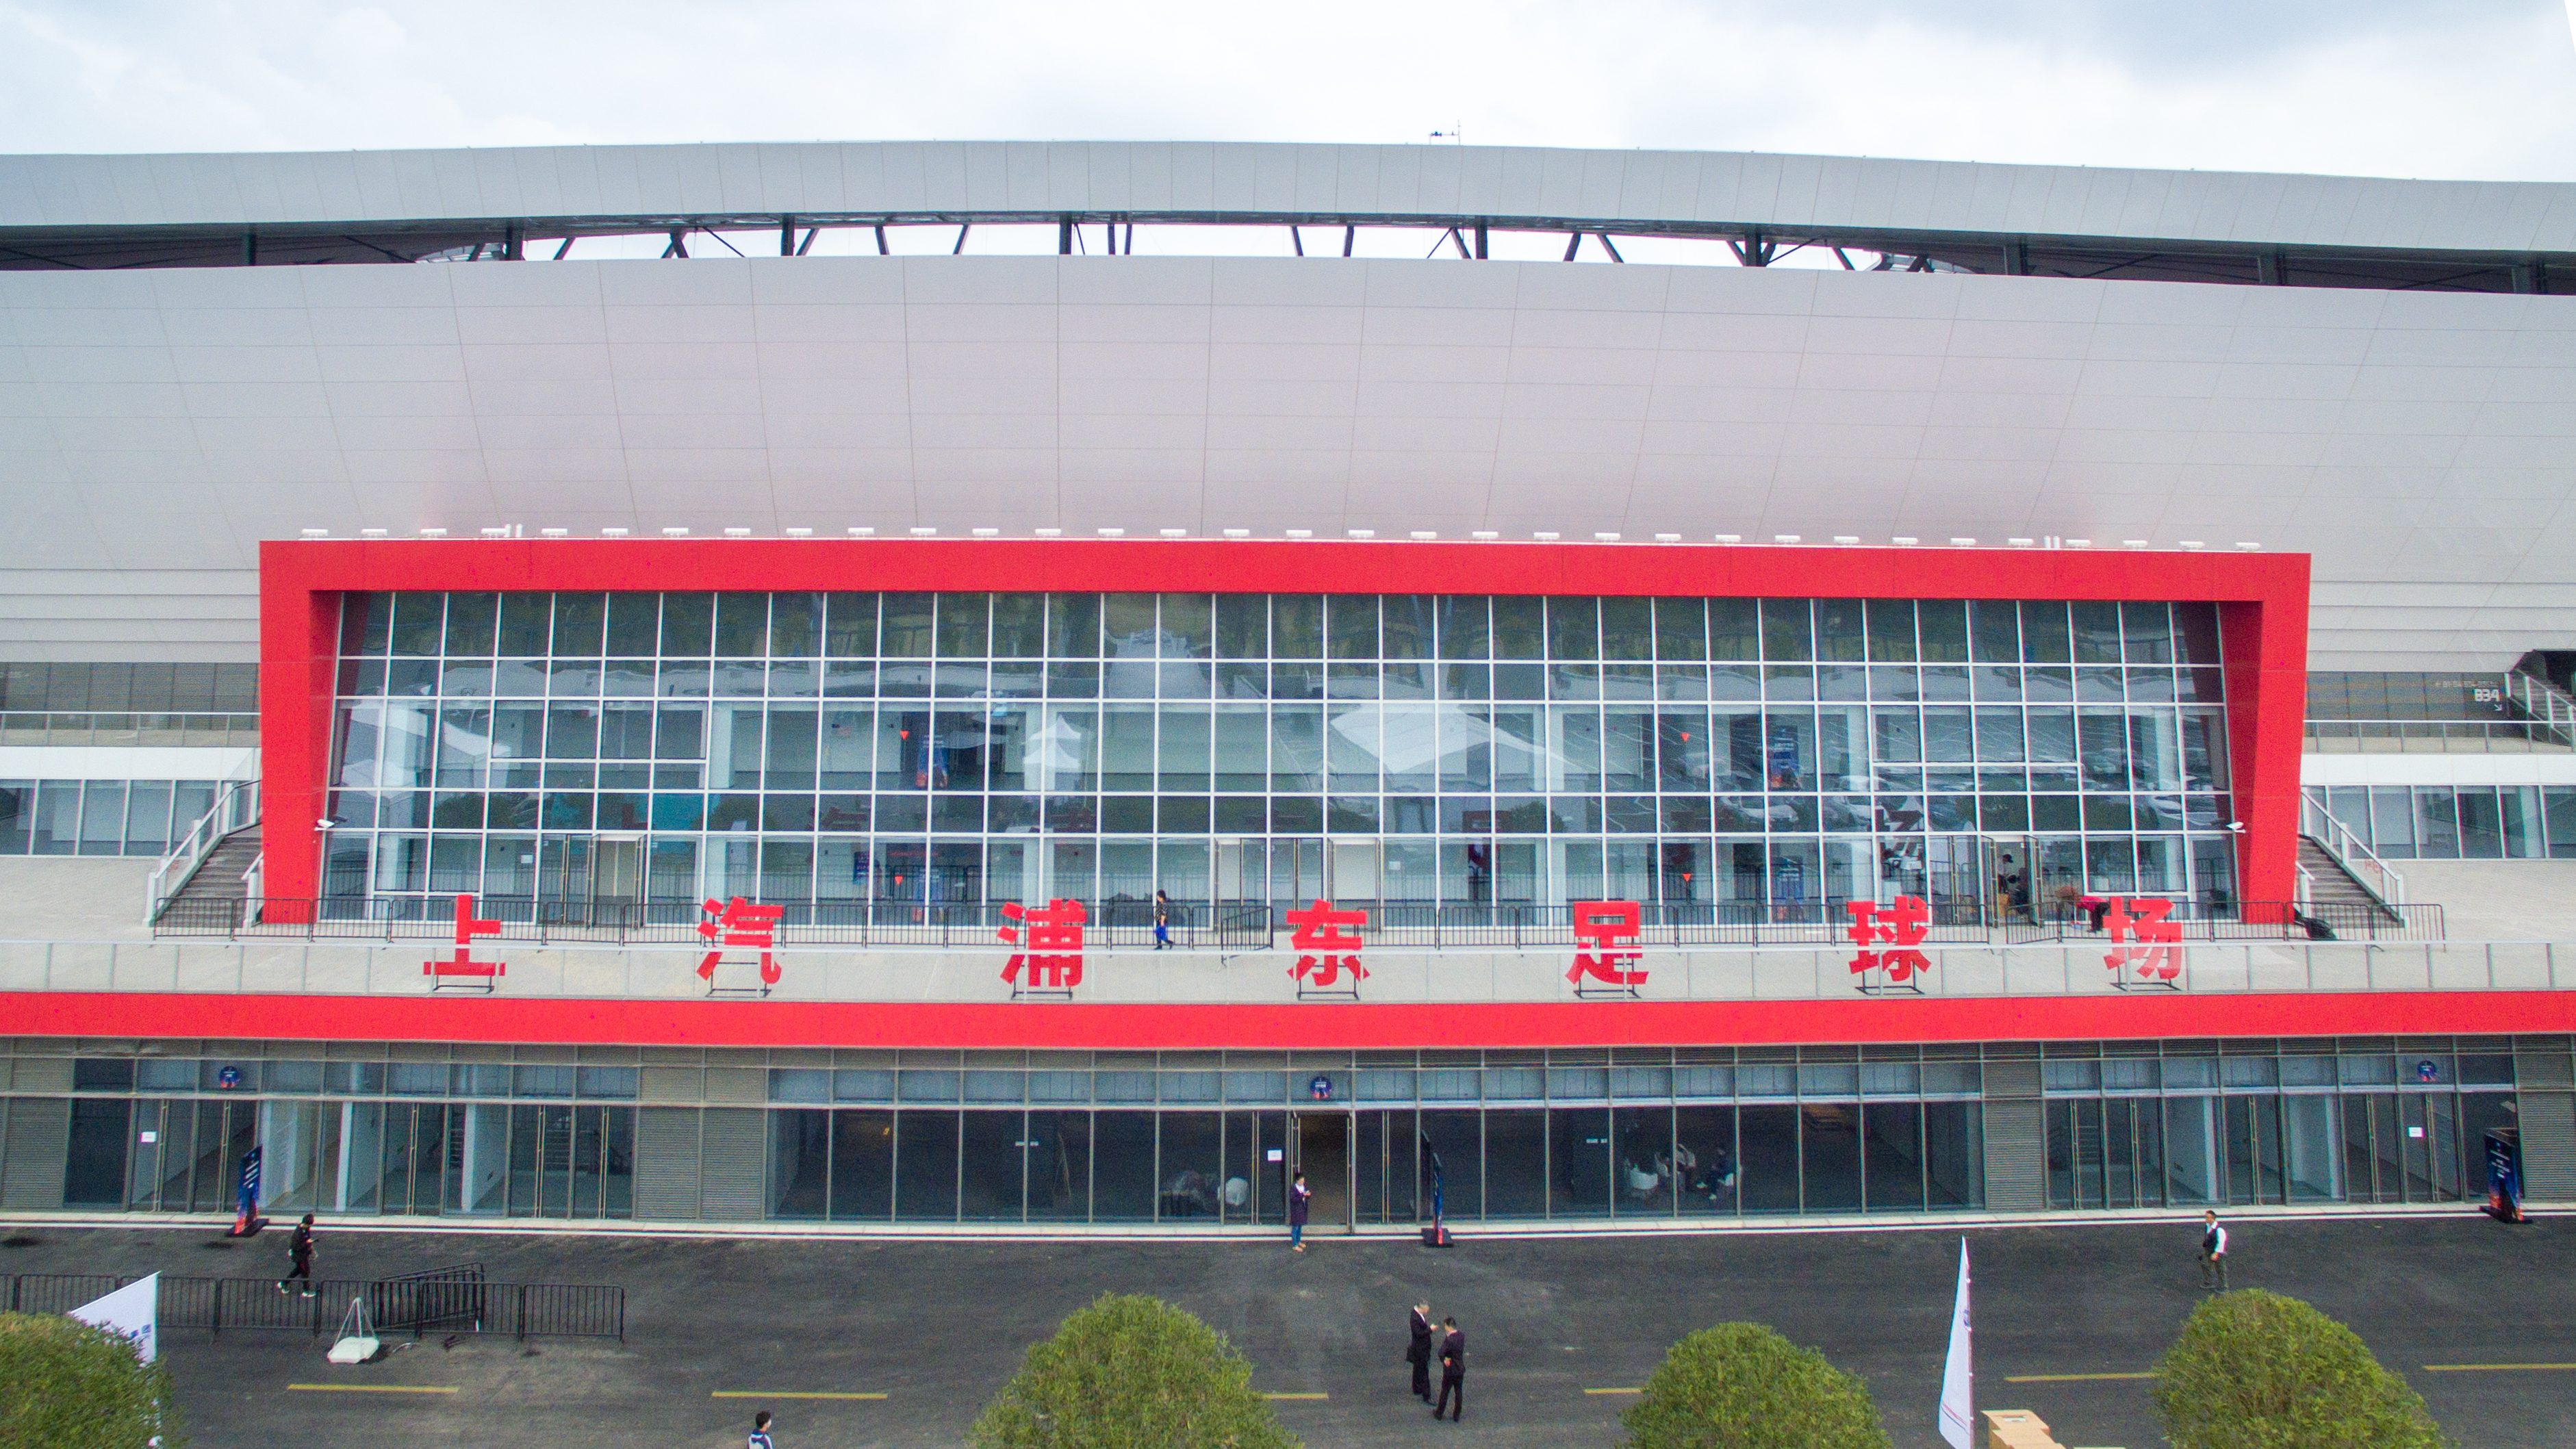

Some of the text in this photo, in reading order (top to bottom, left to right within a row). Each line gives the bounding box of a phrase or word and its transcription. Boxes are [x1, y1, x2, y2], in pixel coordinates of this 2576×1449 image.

[423, 894, 2184, 988] 上汽浦东足球场
